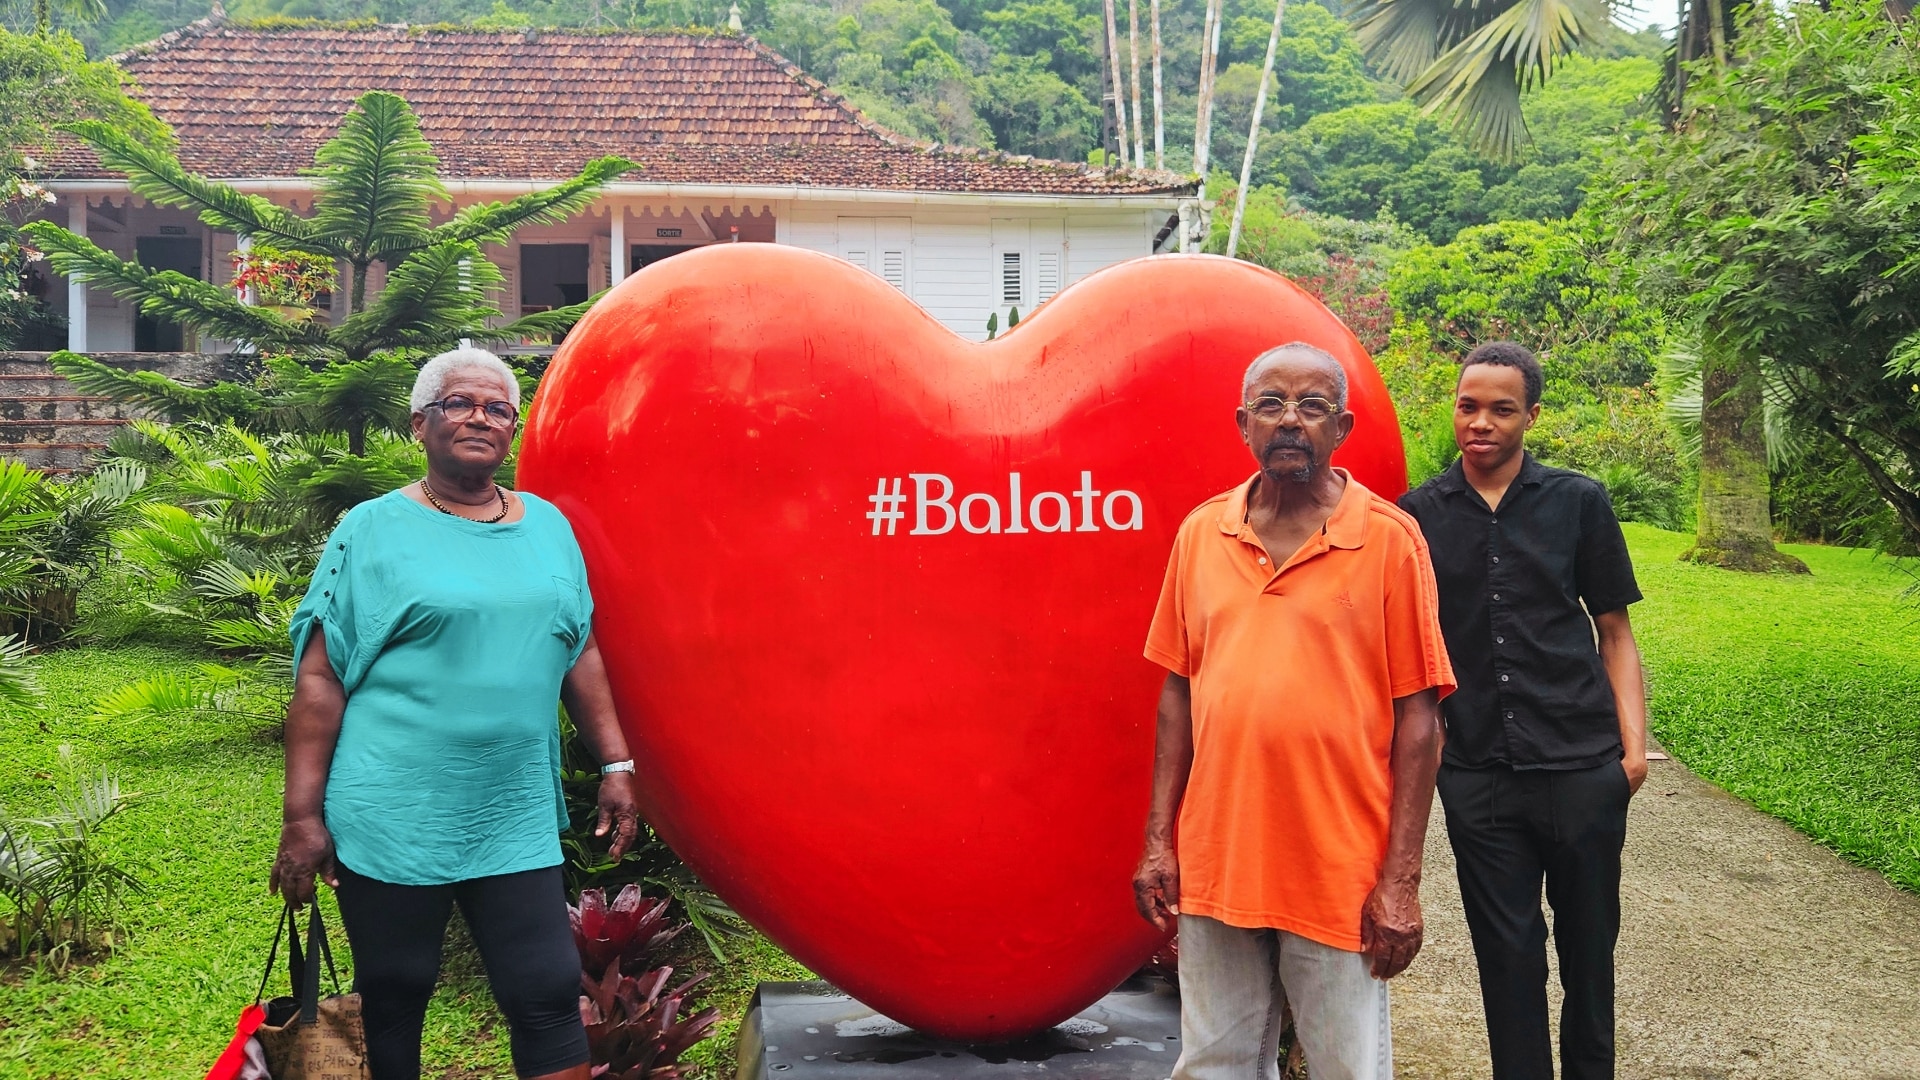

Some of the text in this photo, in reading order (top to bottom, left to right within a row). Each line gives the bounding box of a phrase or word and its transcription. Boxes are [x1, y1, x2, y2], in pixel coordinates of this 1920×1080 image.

[658, 229, 681, 237] SORTIE
[866, 471, 1144, 536] #Balata
[324, 1054, 357, 1069] PARIS
